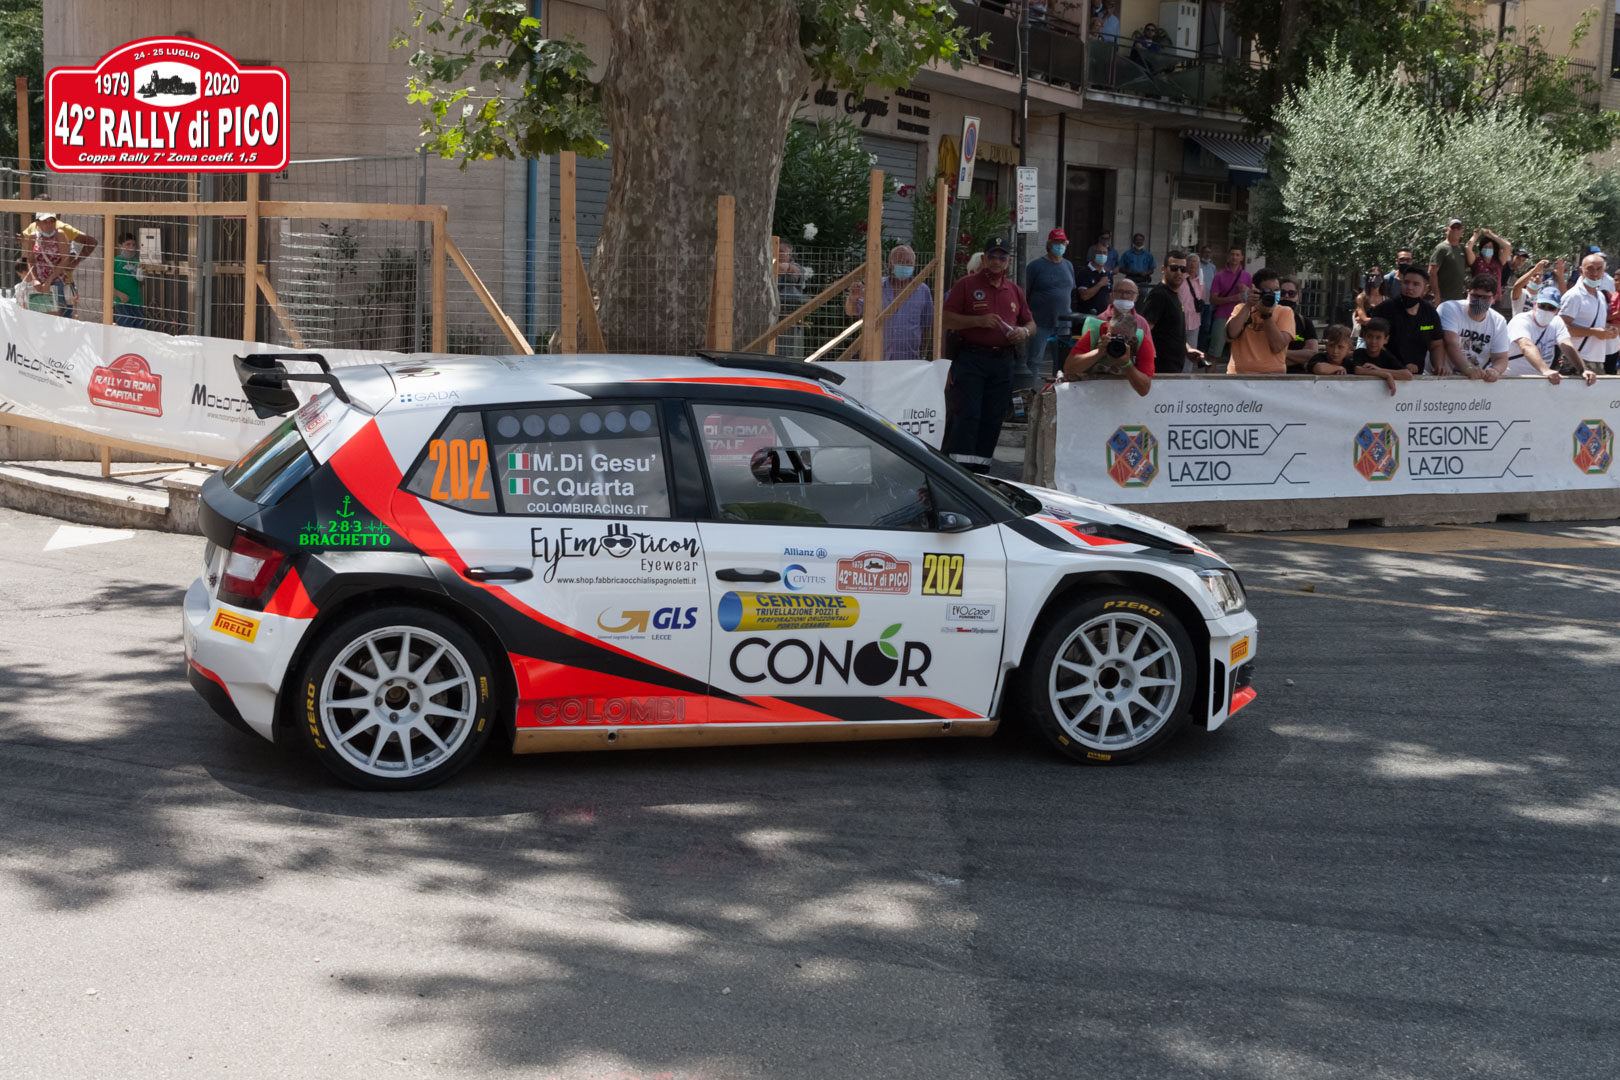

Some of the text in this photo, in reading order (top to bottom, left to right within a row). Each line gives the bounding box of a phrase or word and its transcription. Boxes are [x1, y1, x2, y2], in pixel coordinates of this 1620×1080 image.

[94, 374, 123, 388] RALLY
[132, 381, 157, 393] ROMA
[104, 389, 144, 402] CAPITALE
[414, 390, 460, 402] GADA
[909, 408, 936, 419] Italia
[1154, 400, 1263, 416] con il sostegno della
[1395, 399, 1492, 414] con il sostegno della
[723, 426, 769, 436] ROMA
[1408, 426, 1488, 446] REGIONE
[1168, 429, 1259, 450] REGIONE
[429, 439, 490, 500] 202
[533, 454, 583, 472] M.Di
[1408, 456, 1464, 476] LAZIO
[1168, 461, 1231, 482] LAZIO
[533, 477, 635, 497] C.Quarta
[527, 503, 648, 516] COLOMBIRACING.IT
[299, 533, 391, 546] BRACHETTO
[784, 548, 814, 556] Allianz
[641, 558, 698, 572] Eyewear
[557, 576, 696, 585] www.shop.fabbricaocchialispagnoletti.it
[794, 575, 826, 584] CIVITUS
[853, 571, 878, 586] RALLY
[880, 573, 887, 586] di
[889, 572, 908, 587] PICO
[922, 553, 964, 595] 202
[756, 594, 847, 608] CENTONZE
[1103, 600, 1161, 617] PZERO
[653, 607, 698, 630] GLS
[756, 608, 812, 616] TRIVELLAZIONE
[814, 608, 834, 616] POZZI
[215, 612, 254, 638] PIRELLI
[1231, 641, 1247, 661] PIRELLI
[533, 697, 686, 724] COLOMBI
